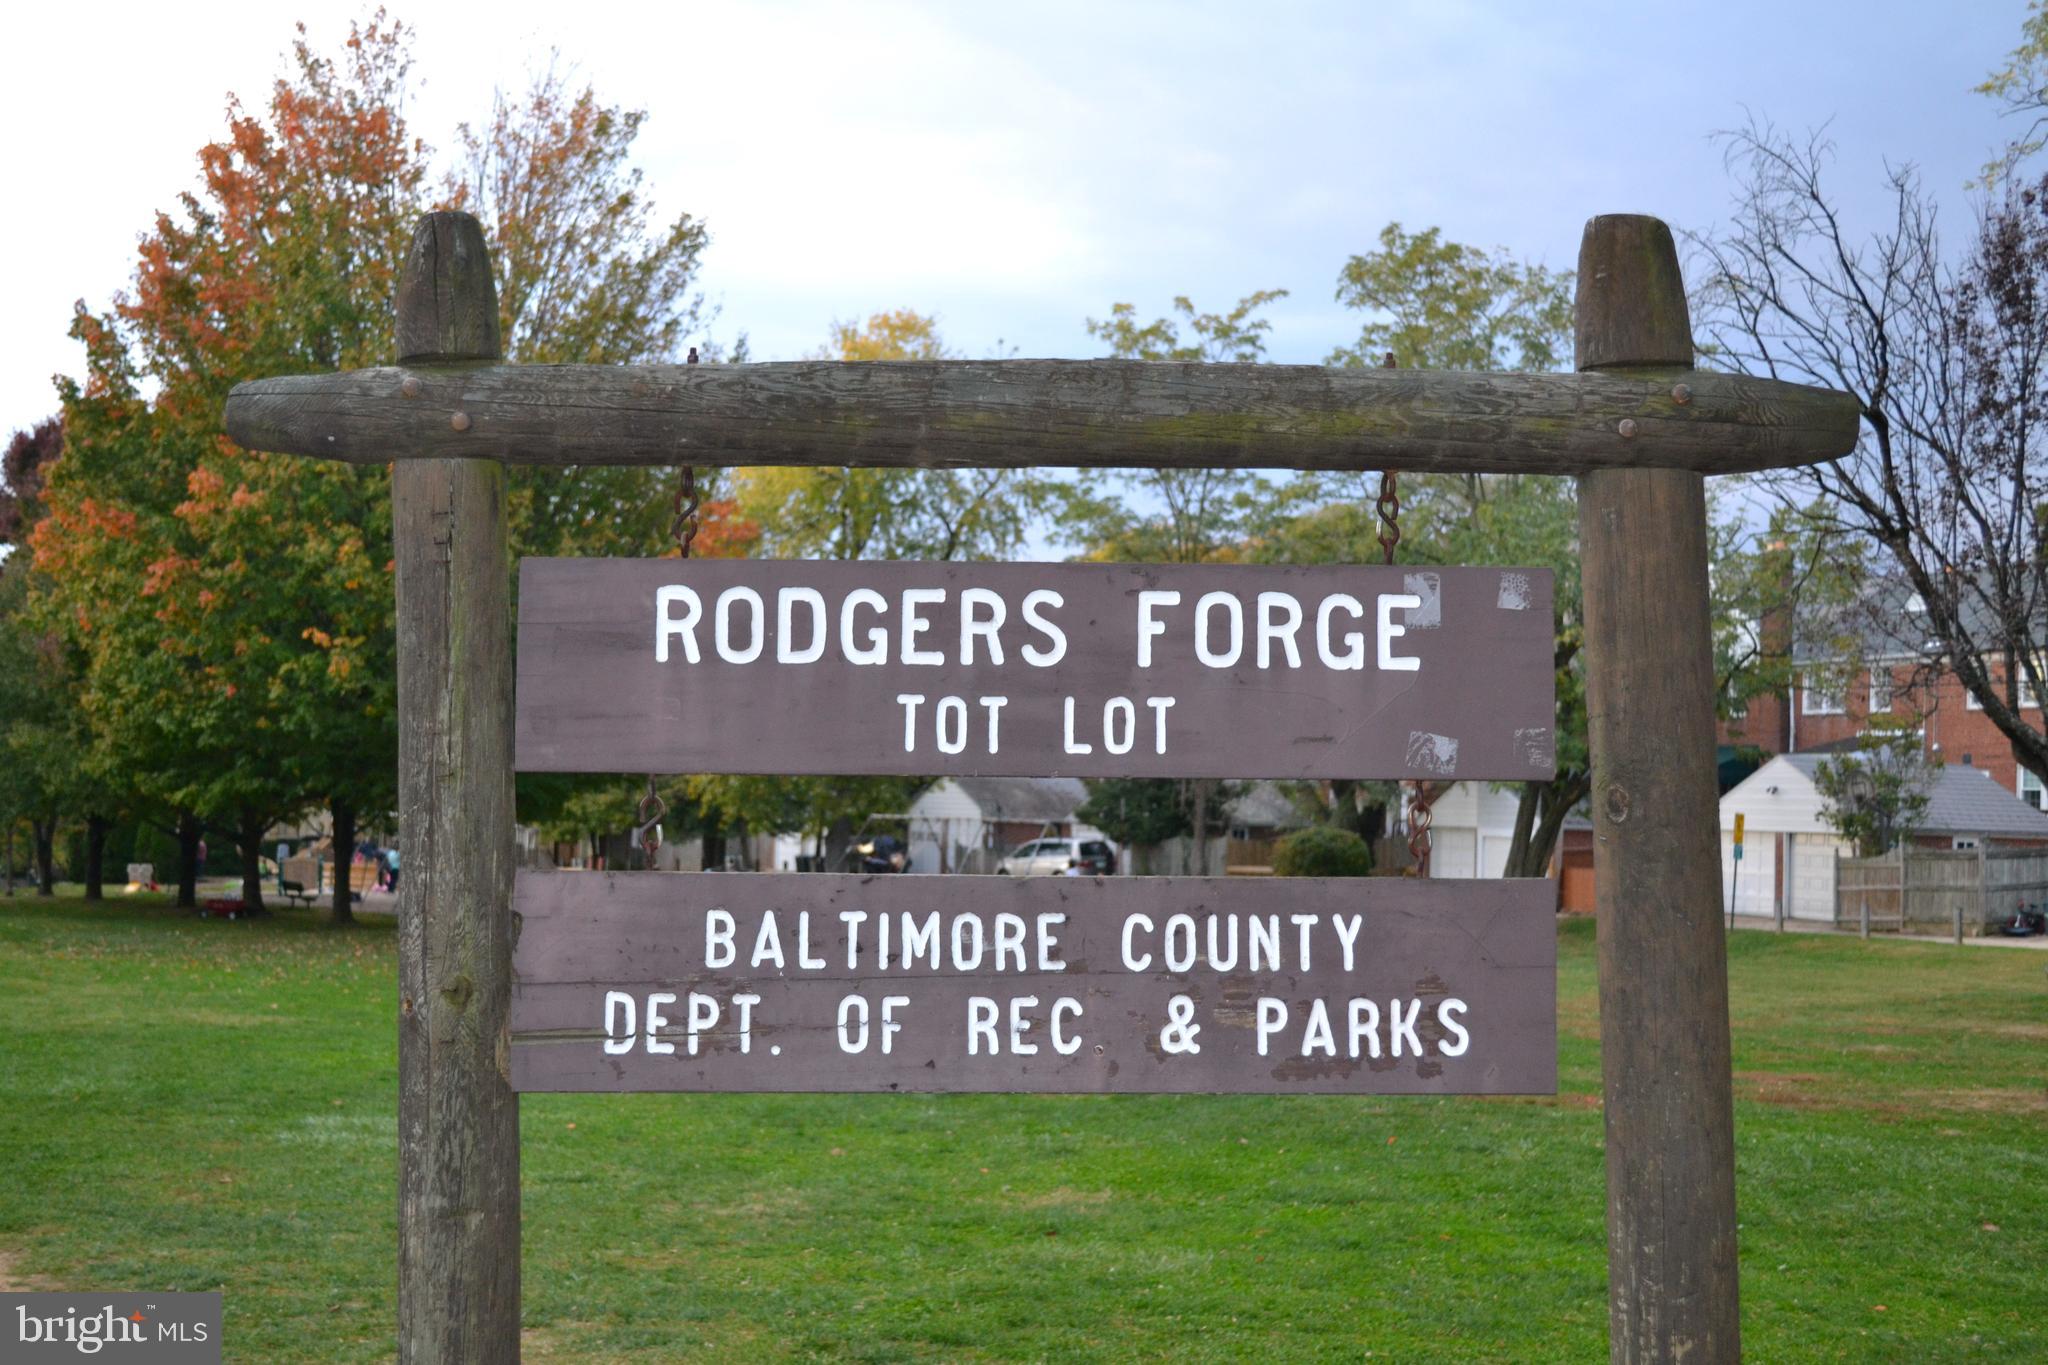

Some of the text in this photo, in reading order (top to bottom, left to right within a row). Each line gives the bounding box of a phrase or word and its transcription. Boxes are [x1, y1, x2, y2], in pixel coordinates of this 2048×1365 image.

[654, 584, 1422, 673] RODGERS FORGE
[896, 693, 1177, 756] TOT LOT
[704, 909, 1363, 973] BALTIMORE COUNTY
[603, 990, 1470, 1058] DEPT. OF REC & PARKS
